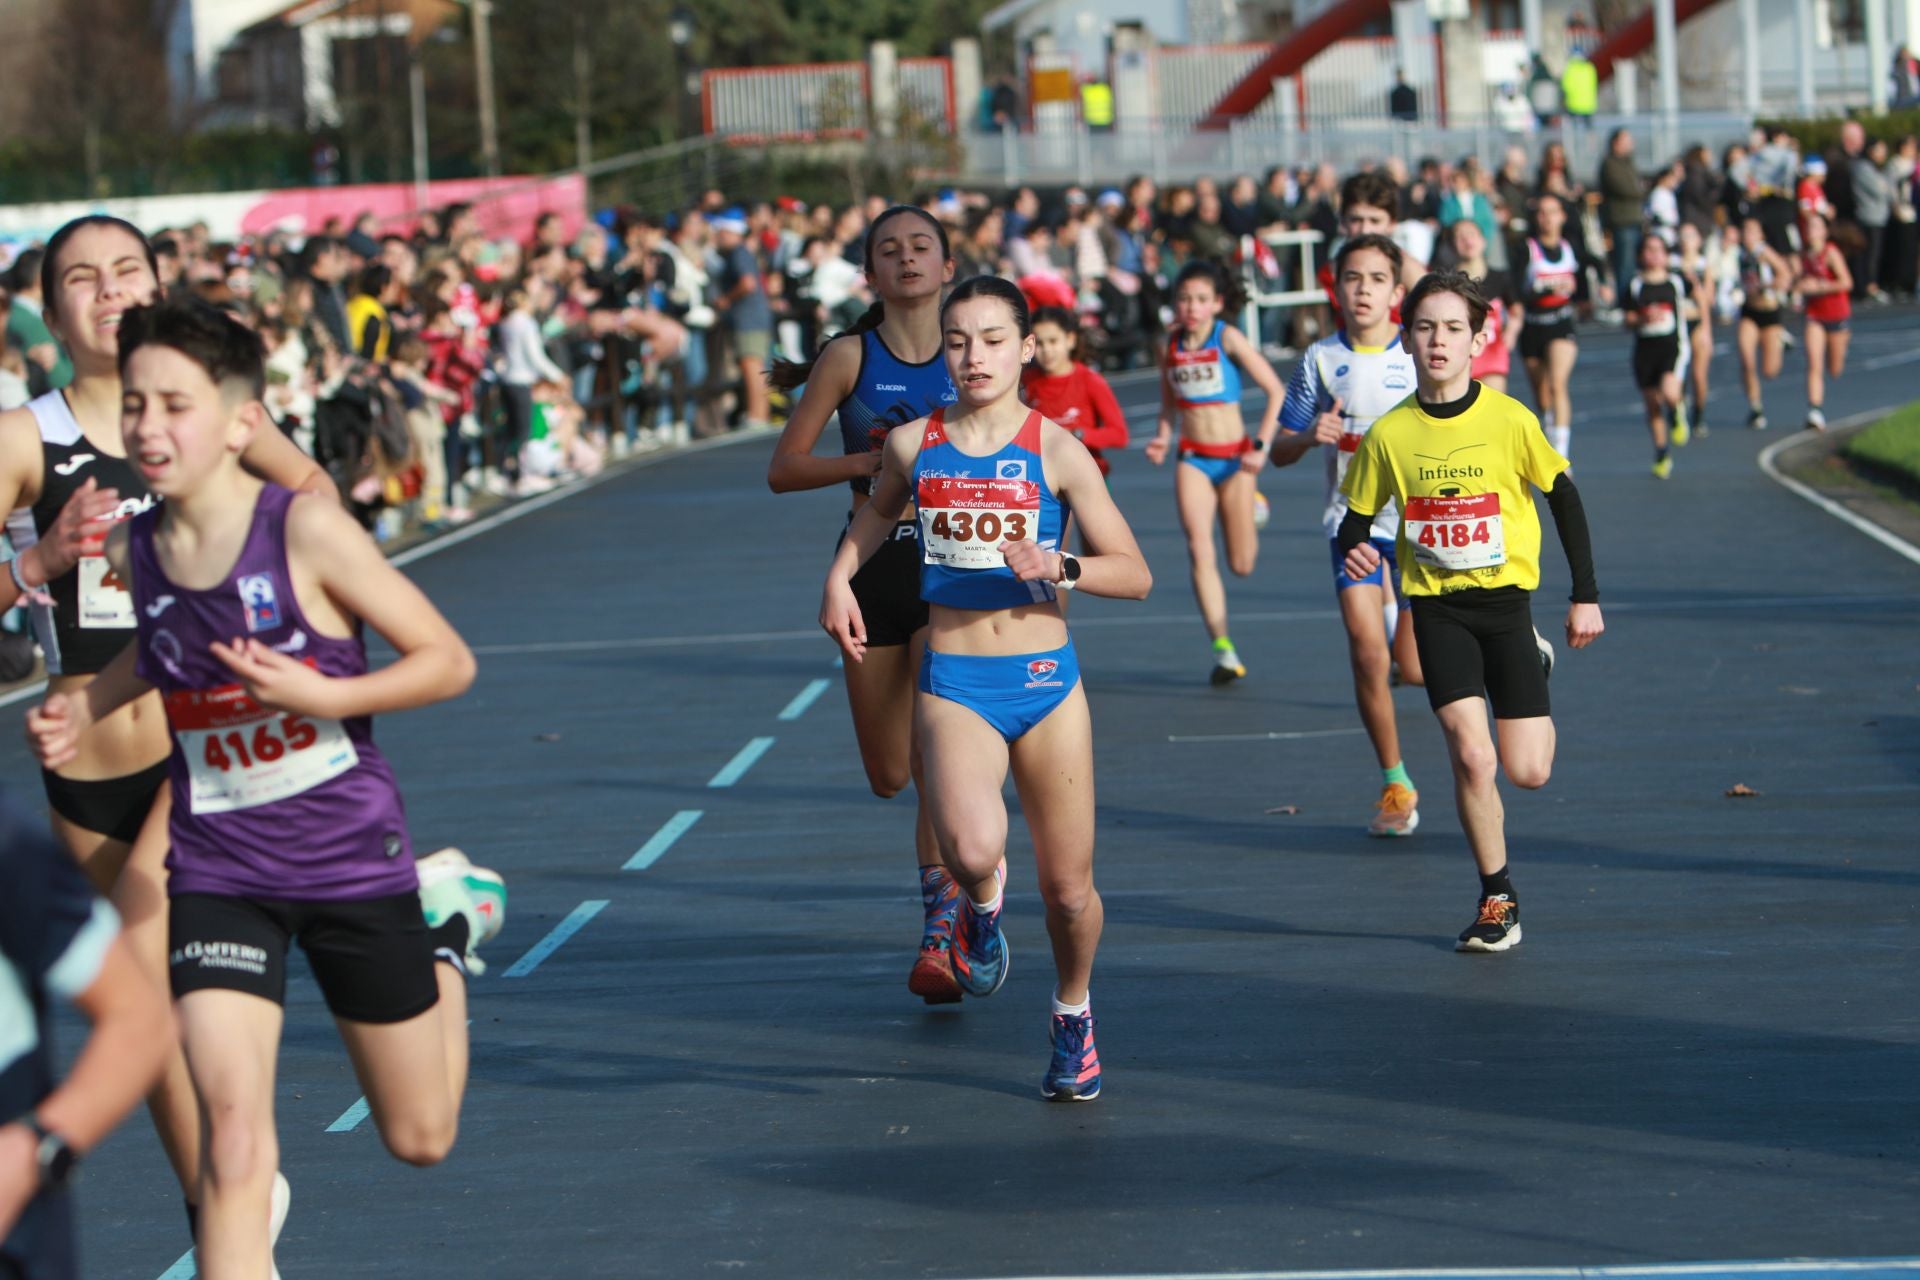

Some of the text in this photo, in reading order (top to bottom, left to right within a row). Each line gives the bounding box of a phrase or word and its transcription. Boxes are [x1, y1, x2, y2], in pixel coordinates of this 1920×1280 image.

[1418, 464, 1484, 481] Infiesto
[948, 499, 1006, 509] Nochebuena
[931, 511, 1027, 543] 4303
[1417, 521, 1491, 548] 4184
[204, 715, 318, 772] 4165
[184, 940, 268, 963] GAITERO
